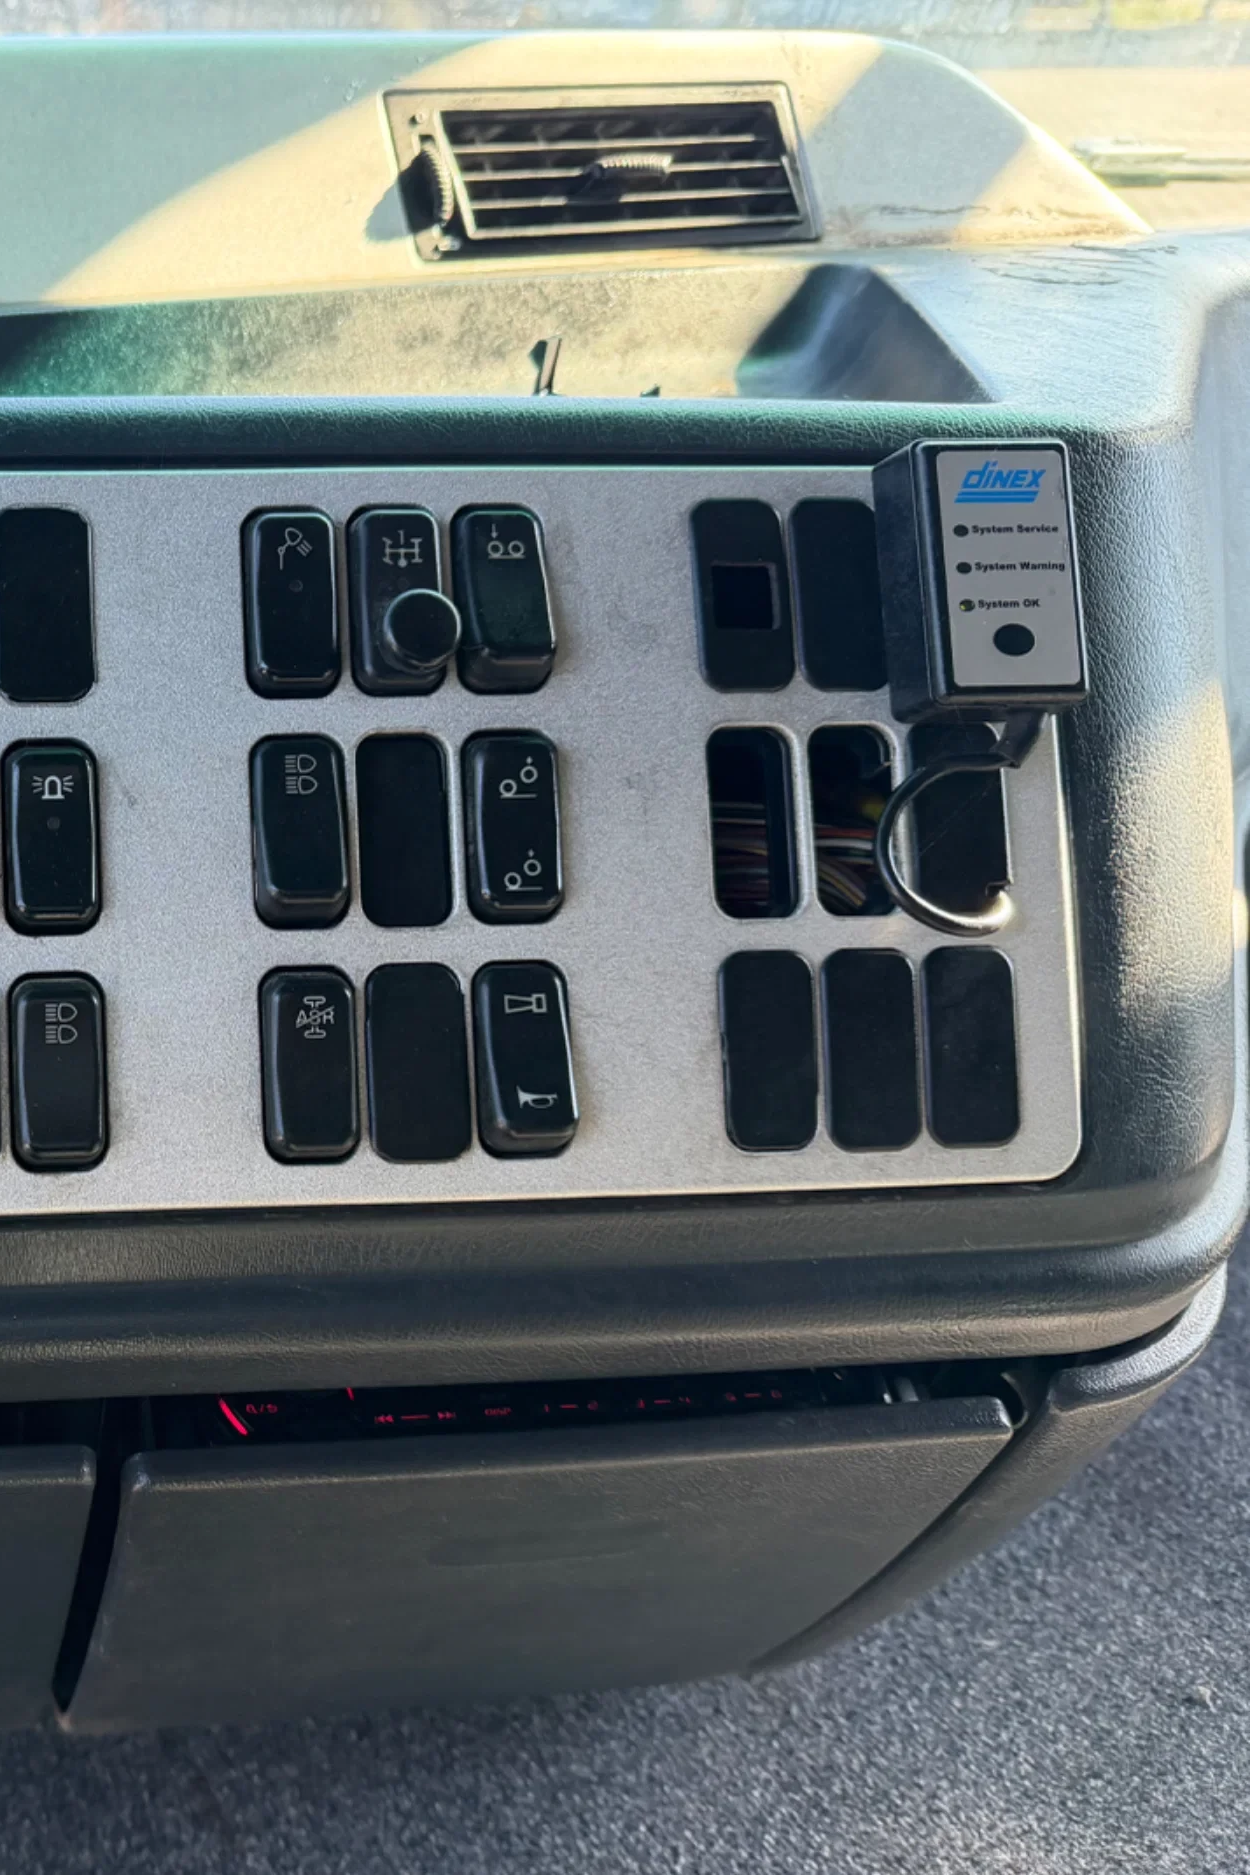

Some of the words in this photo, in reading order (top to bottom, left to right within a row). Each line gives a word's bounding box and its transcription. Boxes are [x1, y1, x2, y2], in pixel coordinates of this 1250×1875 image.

[971, 525, 1013, 535] System
[1017, 524, 1058, 533] Service
[975, 562, 1016, 573] System
[1021, 561, 1065, 571] Warning
[978, 599, 1019, 610] System
[1024, 598, 1040, 607] OK
